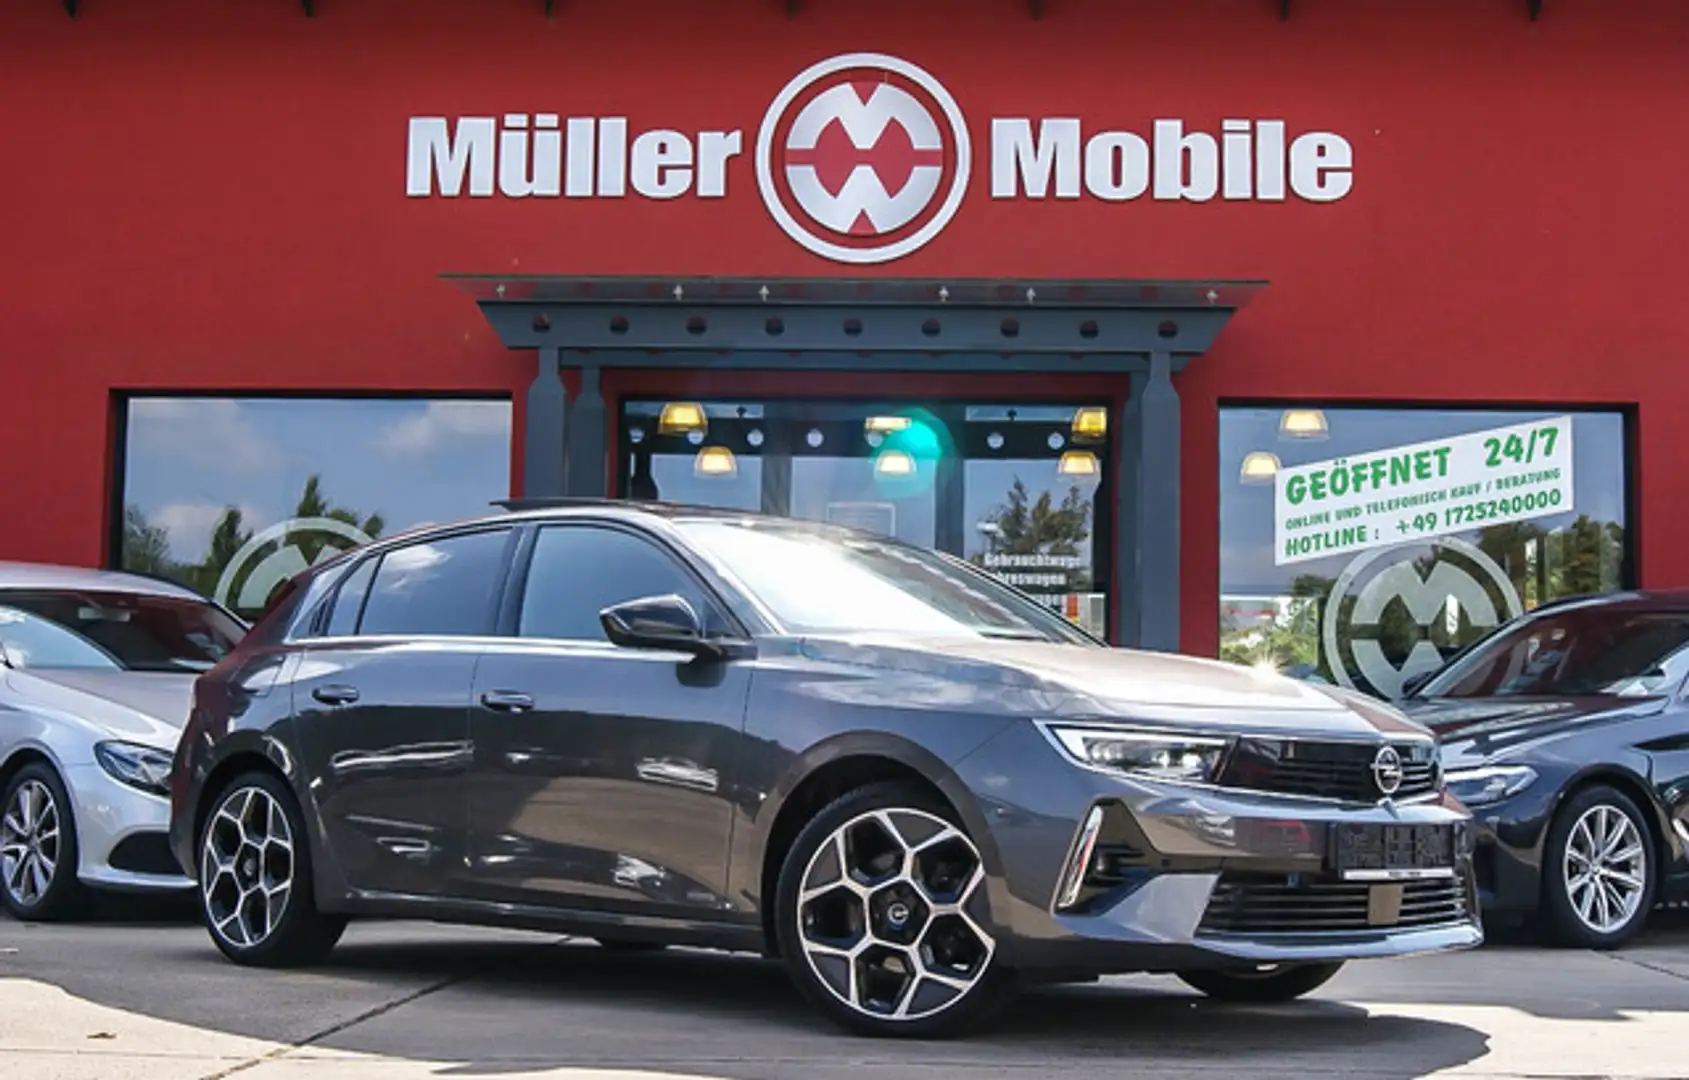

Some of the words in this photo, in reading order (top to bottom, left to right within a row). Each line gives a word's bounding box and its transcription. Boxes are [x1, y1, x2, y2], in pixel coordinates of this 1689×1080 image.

[406, 113, 742, 199] Müller
[991, 117, 1354, 202] Mobile
[1286, 447, 1451, 505] GEÖFFNET
[1484, 427, 1558, 467] 24/7
[1286, 510, 1330, 530] ONLINE
[1335, 506, 1362, 521] UND
[1366, 489, 1447, 514] TELEFONISCH
[1450, 483, 1481, 498] KAUF
[1496, 468, 1561, 490] BERATUNG
[1286, 525, 1367, 557] HOTLINE
[1396, 512, 1437, 535] +49
[1445, 488, 1562, 527] 1725240000
[984, 553, 1082, 569] Gebrauchtwage
